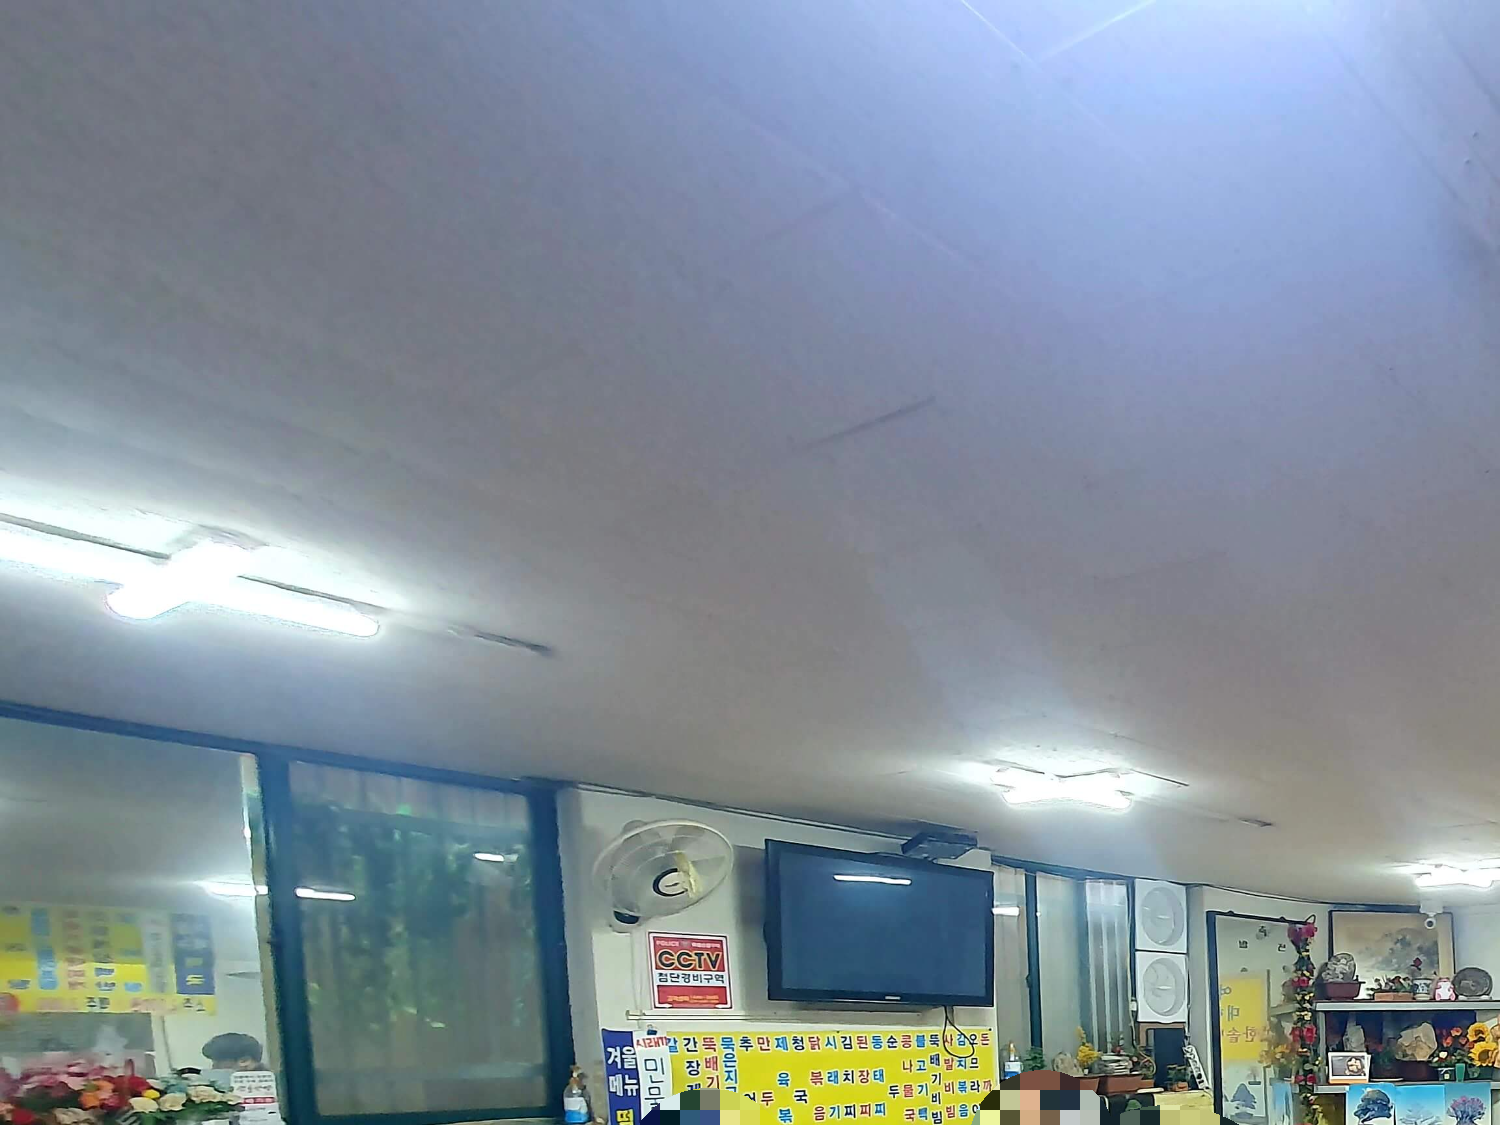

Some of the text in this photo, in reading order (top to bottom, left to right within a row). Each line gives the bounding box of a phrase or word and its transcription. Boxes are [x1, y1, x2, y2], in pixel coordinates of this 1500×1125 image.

[657, 949, 722, 970] CCTV
[658, 972, 724, 984] 첨단경비구역
[607, 1046, 638, 1070] 겨울
[702, 1037, 720, 1089] 뚝배기
[757, 1037, 774, 1106] 만두
[980, 1033, 992, 1091] 돈까
[608, 1073, 639, 1097] 메뉴
[644, 1057, 665, 1109] 민물
